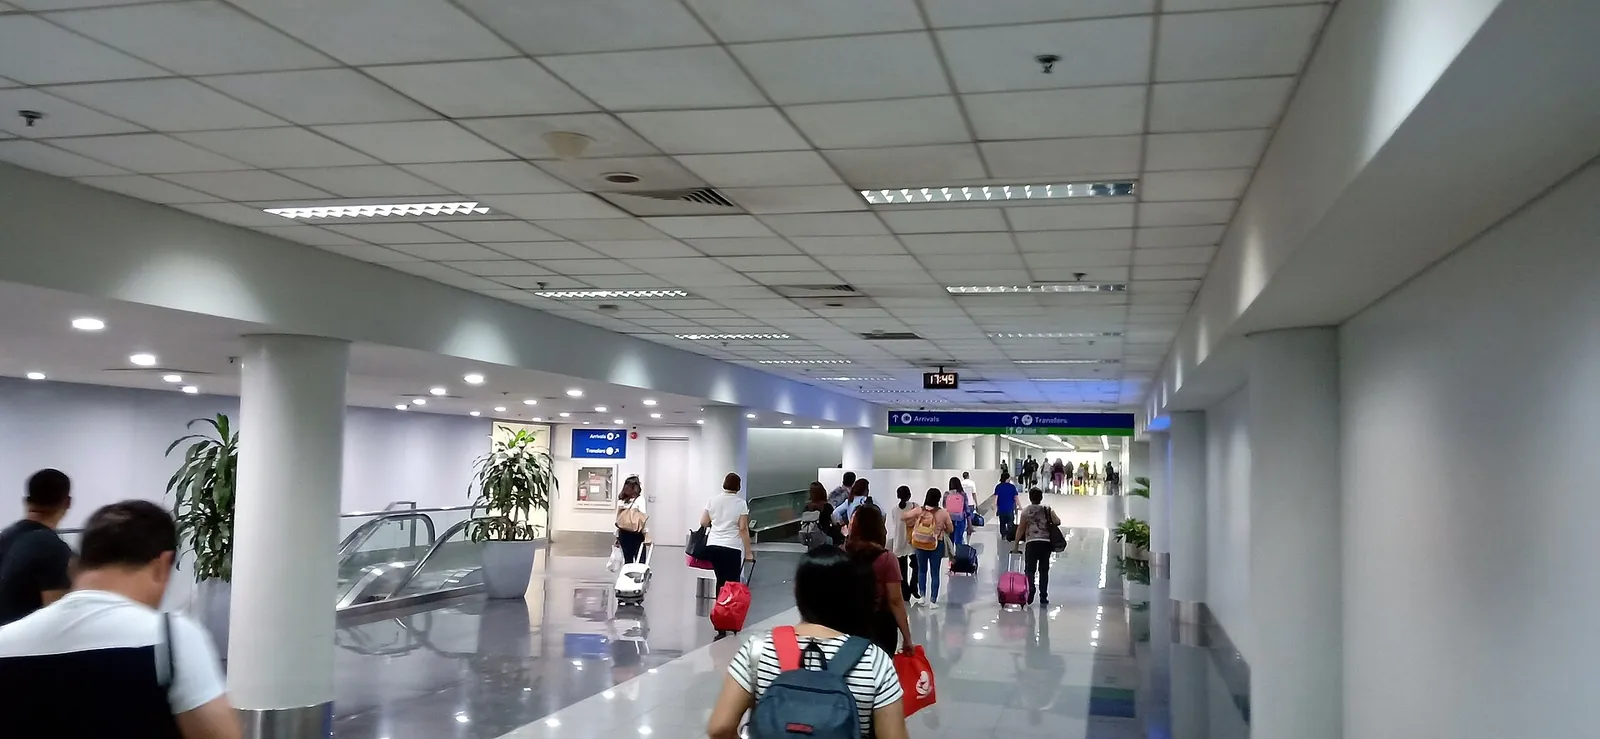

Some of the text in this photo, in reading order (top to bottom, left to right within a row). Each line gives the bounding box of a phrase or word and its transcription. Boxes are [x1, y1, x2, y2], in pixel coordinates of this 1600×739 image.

[930, 374, 955, 385] 17:49
[913, 415, 940, 423] Arrivals
[1035, 416, 1068, 424] Transfers
